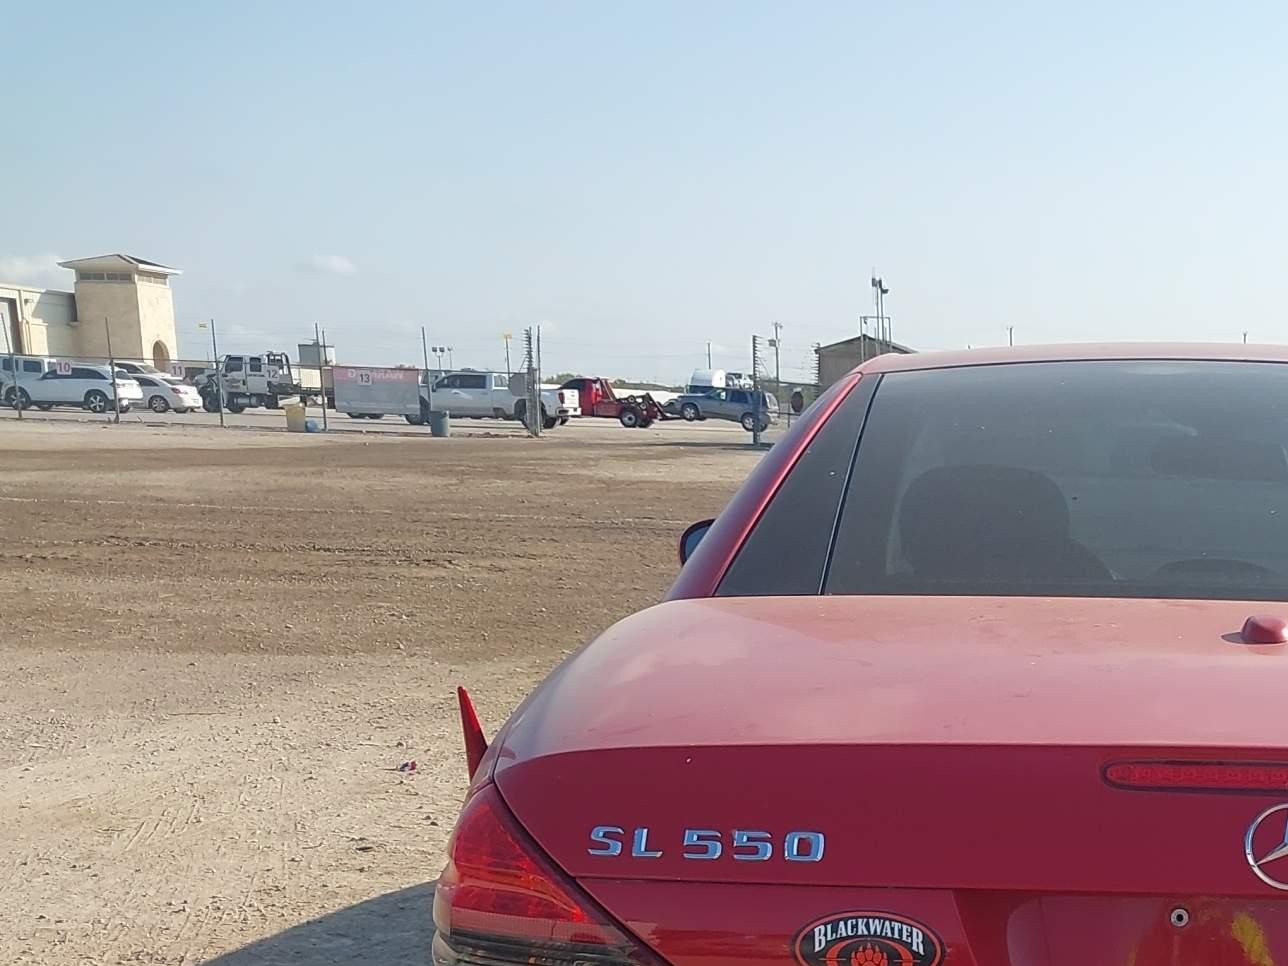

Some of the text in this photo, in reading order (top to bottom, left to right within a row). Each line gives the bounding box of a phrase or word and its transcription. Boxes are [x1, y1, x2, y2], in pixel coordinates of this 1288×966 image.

[360, 373, 370, 383] 13
[587, 825, 826, 862] SL 550
[813, 917, 926, 956] BLACKWATER
